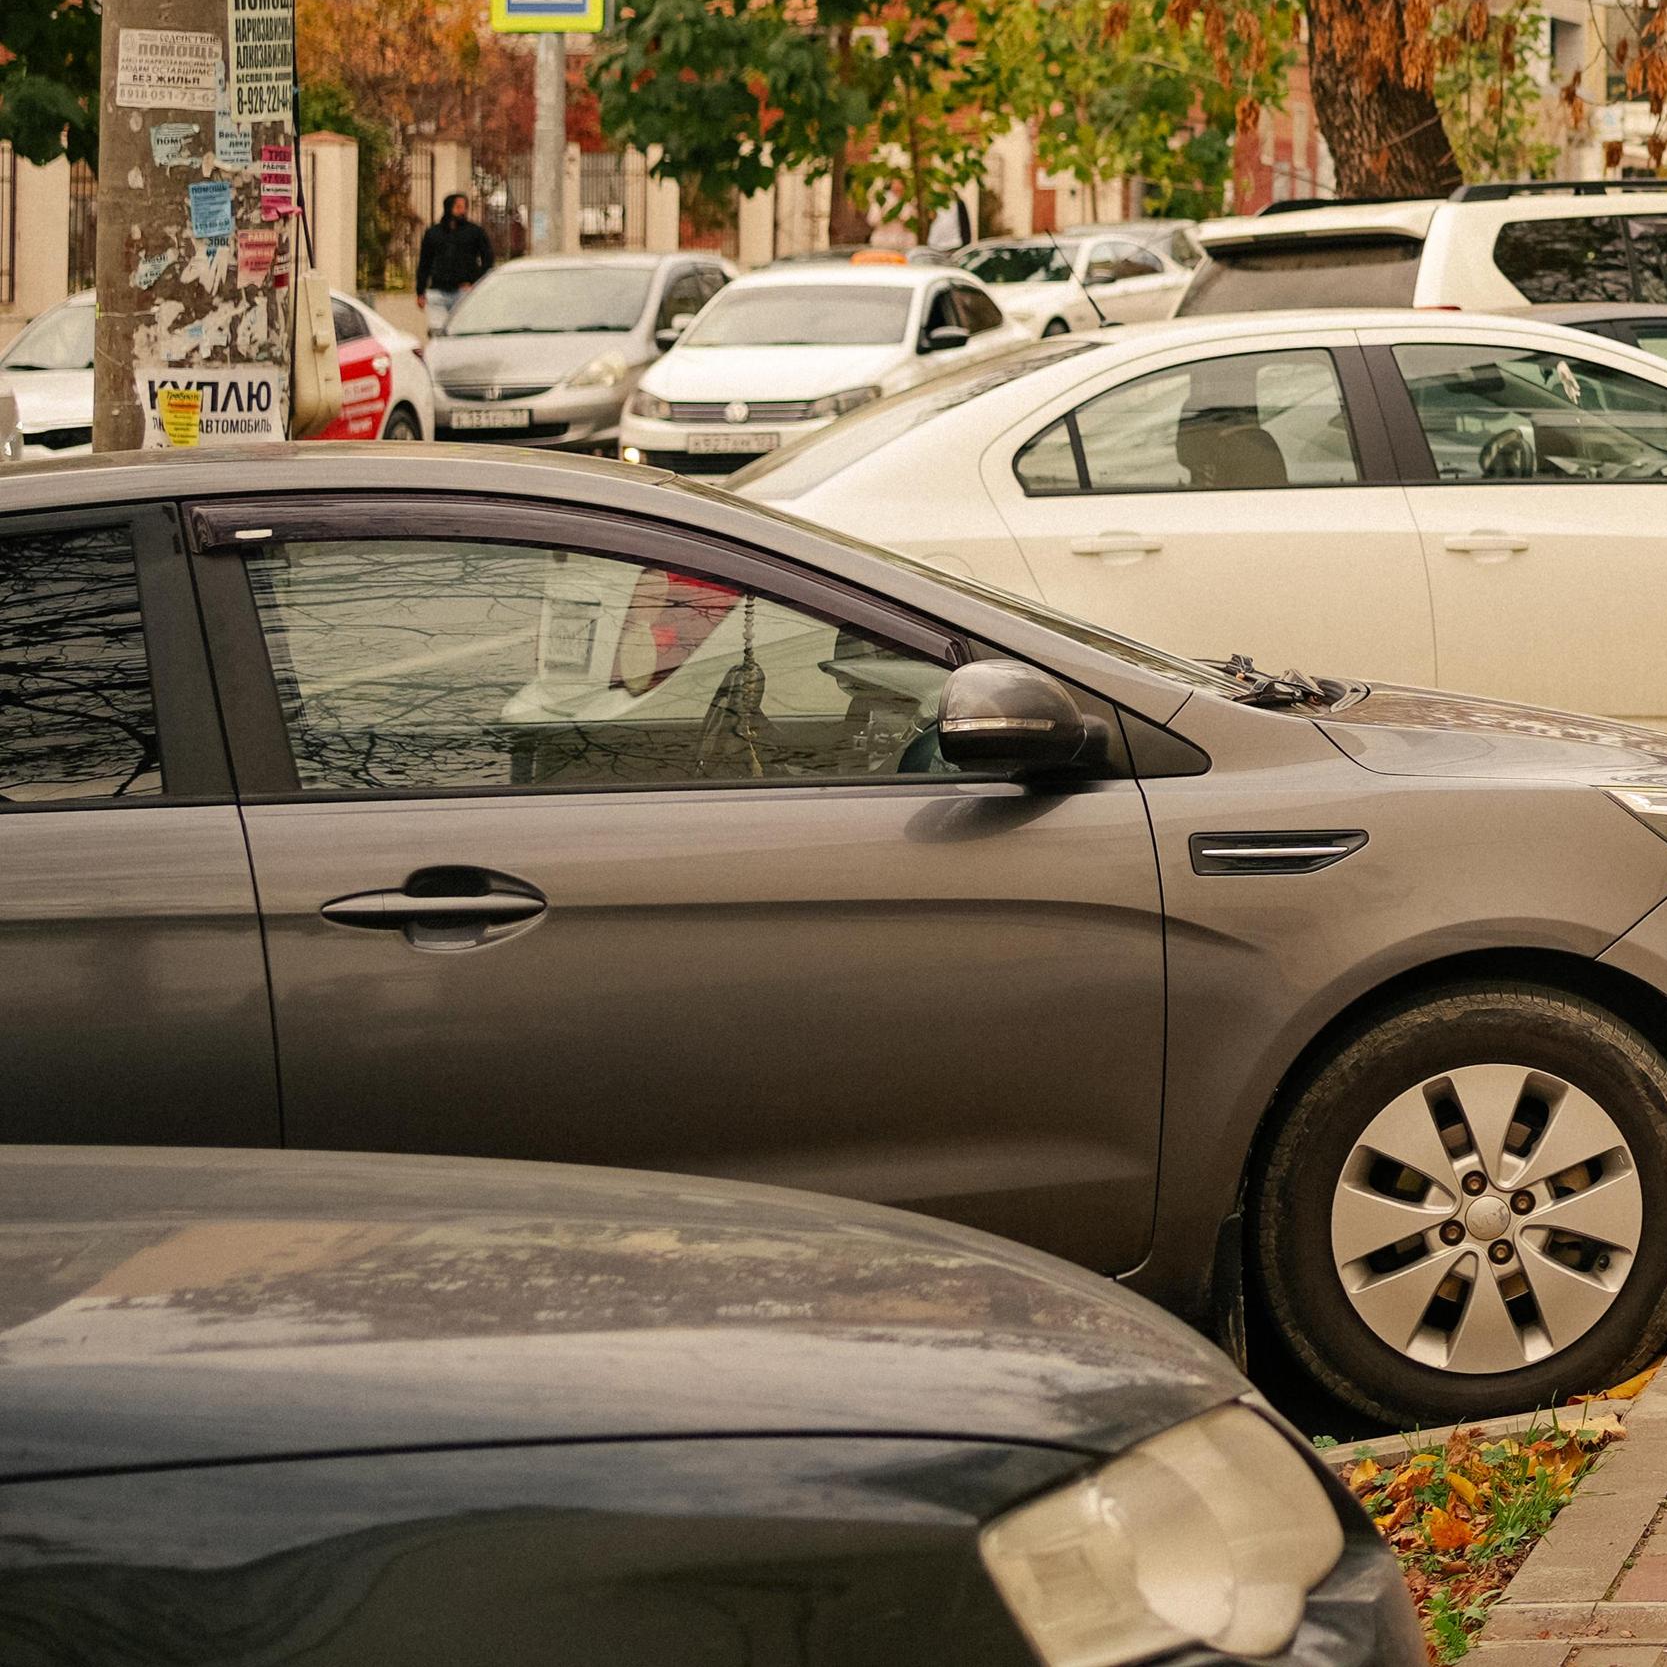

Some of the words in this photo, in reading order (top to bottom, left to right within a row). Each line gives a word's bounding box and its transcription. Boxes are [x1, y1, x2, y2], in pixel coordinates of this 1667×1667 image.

[139, 44, 220, 59] ПОМОЩЬ
[156, 75, 200, 86] ЖИЛЬЯ
[199, 418, 272, 434] АВТОМОБИЛЬ
